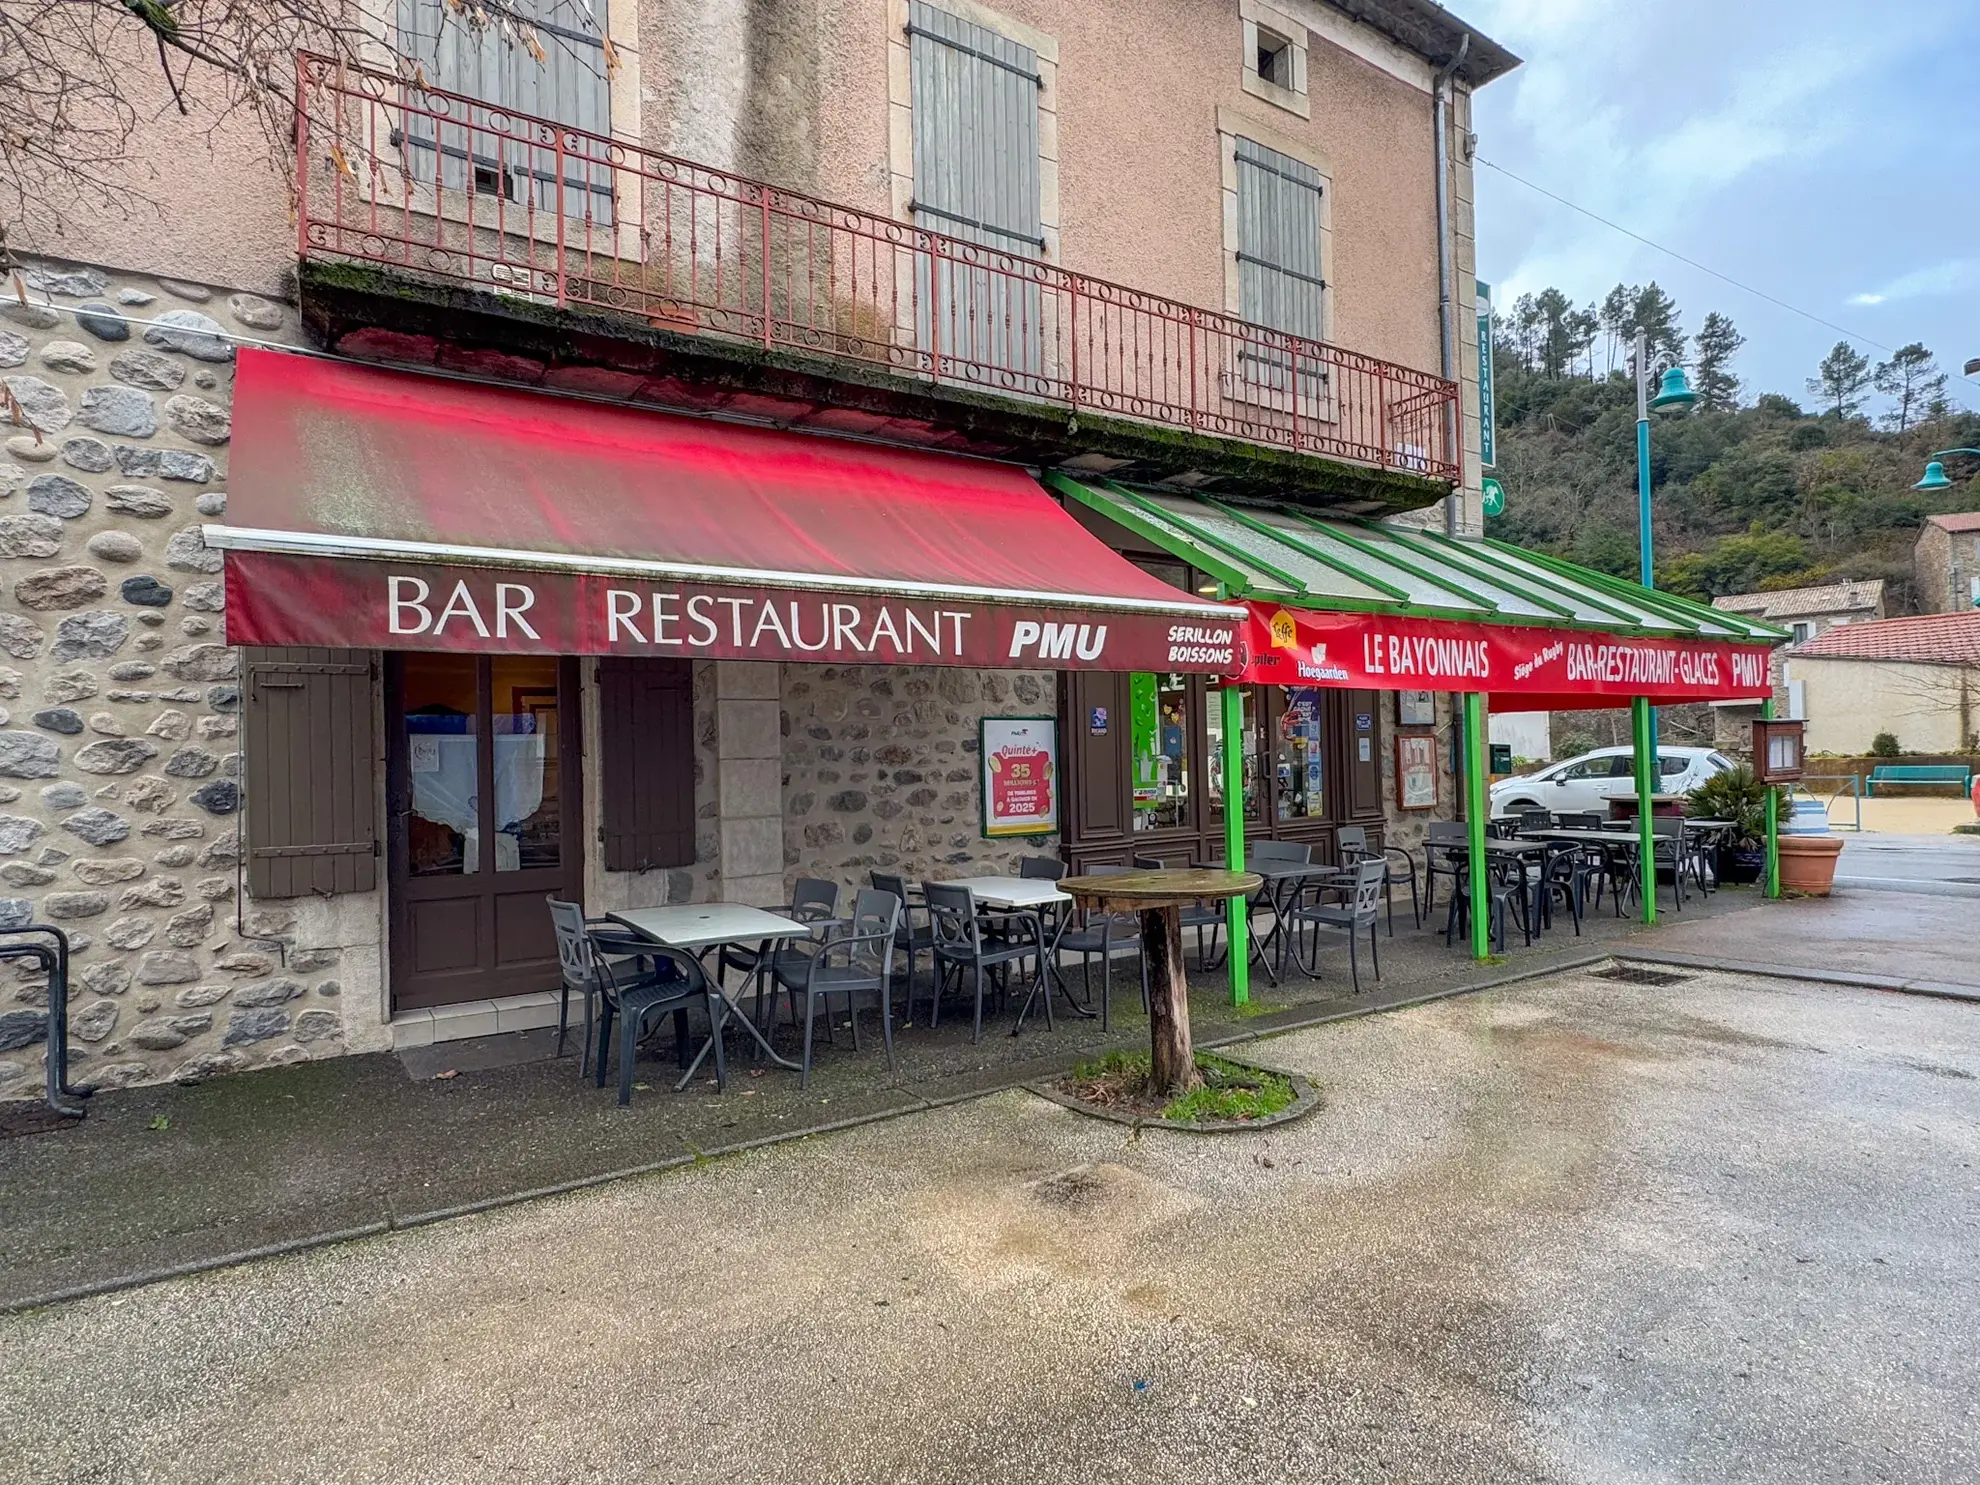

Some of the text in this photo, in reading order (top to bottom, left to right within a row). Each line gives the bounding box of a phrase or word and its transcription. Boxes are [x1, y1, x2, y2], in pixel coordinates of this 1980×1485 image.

[1480, 330, 1490, 453] RESTAURANT
[387, 575, 1108, 661] BAR RESTAURANT PMU
[1167, 625, 1233, 645] SERILLON
[1167, 646, 1233, 664] BOISSONS
[1251, 653, 1281, 667] piler
[1363, 632, 1490, 679] LE BAYONNAIS
[1533, 652, 1543, 668] du
[1542, 640, 1564, 663] Rugby
[1297, 660, 1349, 681] Hoegaarden
[1731, 652, 1763, 687] PMU
[1011, 763, 1031, 778] 35
[1009, 802, 1036, 813] 2025
